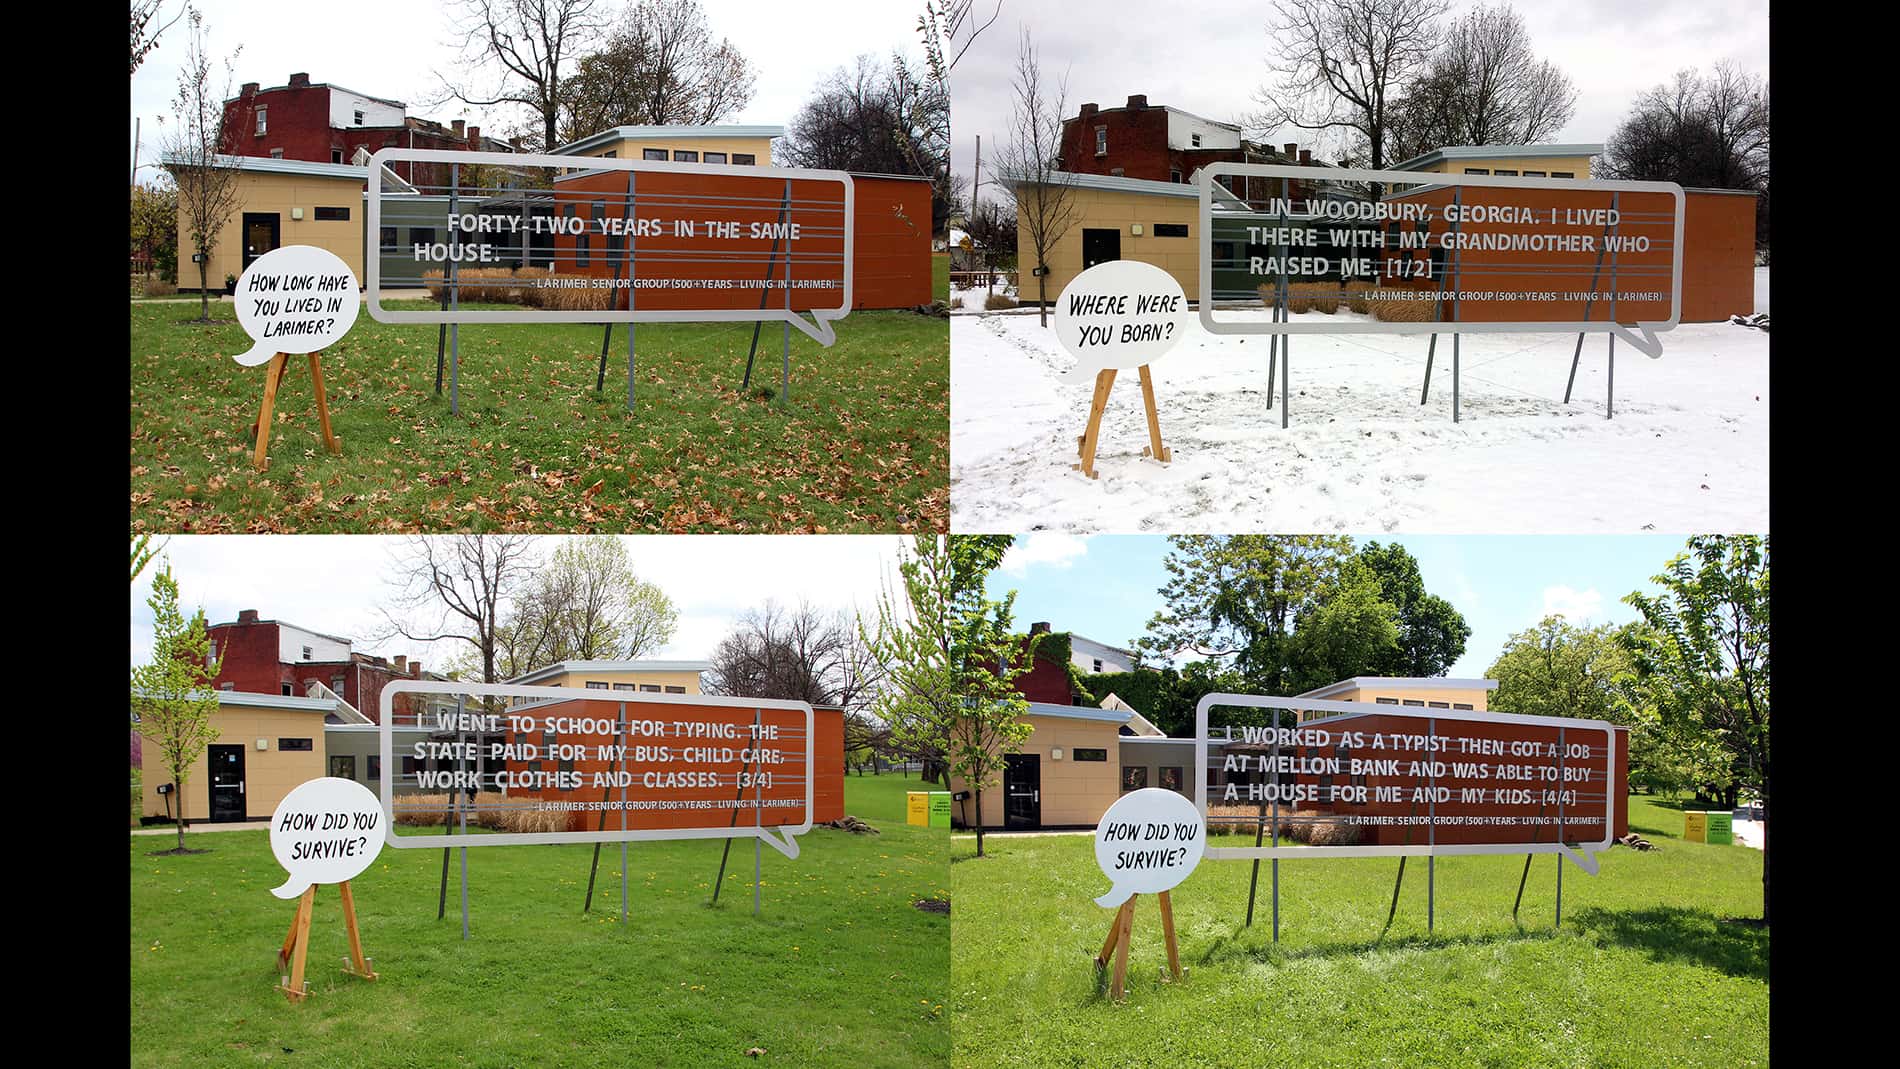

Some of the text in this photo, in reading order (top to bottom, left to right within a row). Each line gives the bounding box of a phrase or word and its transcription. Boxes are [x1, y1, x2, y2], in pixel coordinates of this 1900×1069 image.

[1270, 198, 1621, 226] IN WOODBURY, GEORGIA. I LIVED
[447, 213, 801, 241] FORTY-TWO YEARS IN THE SAME
[1246, 226, 1651, 253] THERE WITH MY GRANDMOTHER WHO
[414, 242, 501, 262] HOUSE.
[1250, 256, 1433, 279] RAISED ME. [1/2]
[249, 273, 350, 292] HOW LONG HAVE
[592, 278, 631, 290] SENIOR
[633, 278, 669, 290] GROUP
[740, 278, 774, 290] LIVING
[777, 278, 789, 290] IN
[791, 278, 836, 290] LARIMER)
[253, 296, 343, 318] YOU LIVED IN
[1069, 293, 1181, 317] WHERE WERE
[1418, 290, 1456, 301] SENIOR
[1458, 291, 1494, 302] GROUP
[1564, 291, 1598, 302] LIVING
[1602, 291, 1614, 302] IN
[1617, 291, 1664, 302] LARIMER)
[263, 318, 335, 338] LARIMER?
[1078, 321, 1175, 348] YOU BORN?
[417, 712, 779, 741] I WENT TO SCHOOL FOR TYPING. THE
[413, 741, 786, 765] STATE PAID FOR MY BUS, CHILD CARE,
[1225, 725, 1591, 760] I WORKED AS A TYPIST THEN GOT A JOB
[415, 770, 773, 790] WORK CLOTHES AND CLASSES. [3/4]
[1224, 754, 1592, 783] AT MELLON BANK AND WAS ABLE TO BUY
[588, 801, 623, 811] SENIOR
[625, 800, 657, 811] GROUP
[717, 799, 747, 809] LIVING
[750, 799, 759, 809] IN
[762, 799, 799, 809] LARIMER)
[1224, 782, 1577, 807] A HOUSE FOR ME AND MY KIDS. [4/4]
[279, 811, 379, 833] HOW DID YOU
[1104, 822, 1198, 842] HOW DID YOU
[1397, 815, 1431, 826] SENIOR
[1433, 815, 1464, 826] GROUP
[1522, 815, 1550, 825] LIVING
[1553, 815, 1562, 825] IN
[1564, 815, 1600, 826] LARIMER)
[291, 836, 368, 861] SURVIVE?
[1115, 847, 1187, 870] SURVIVE?
